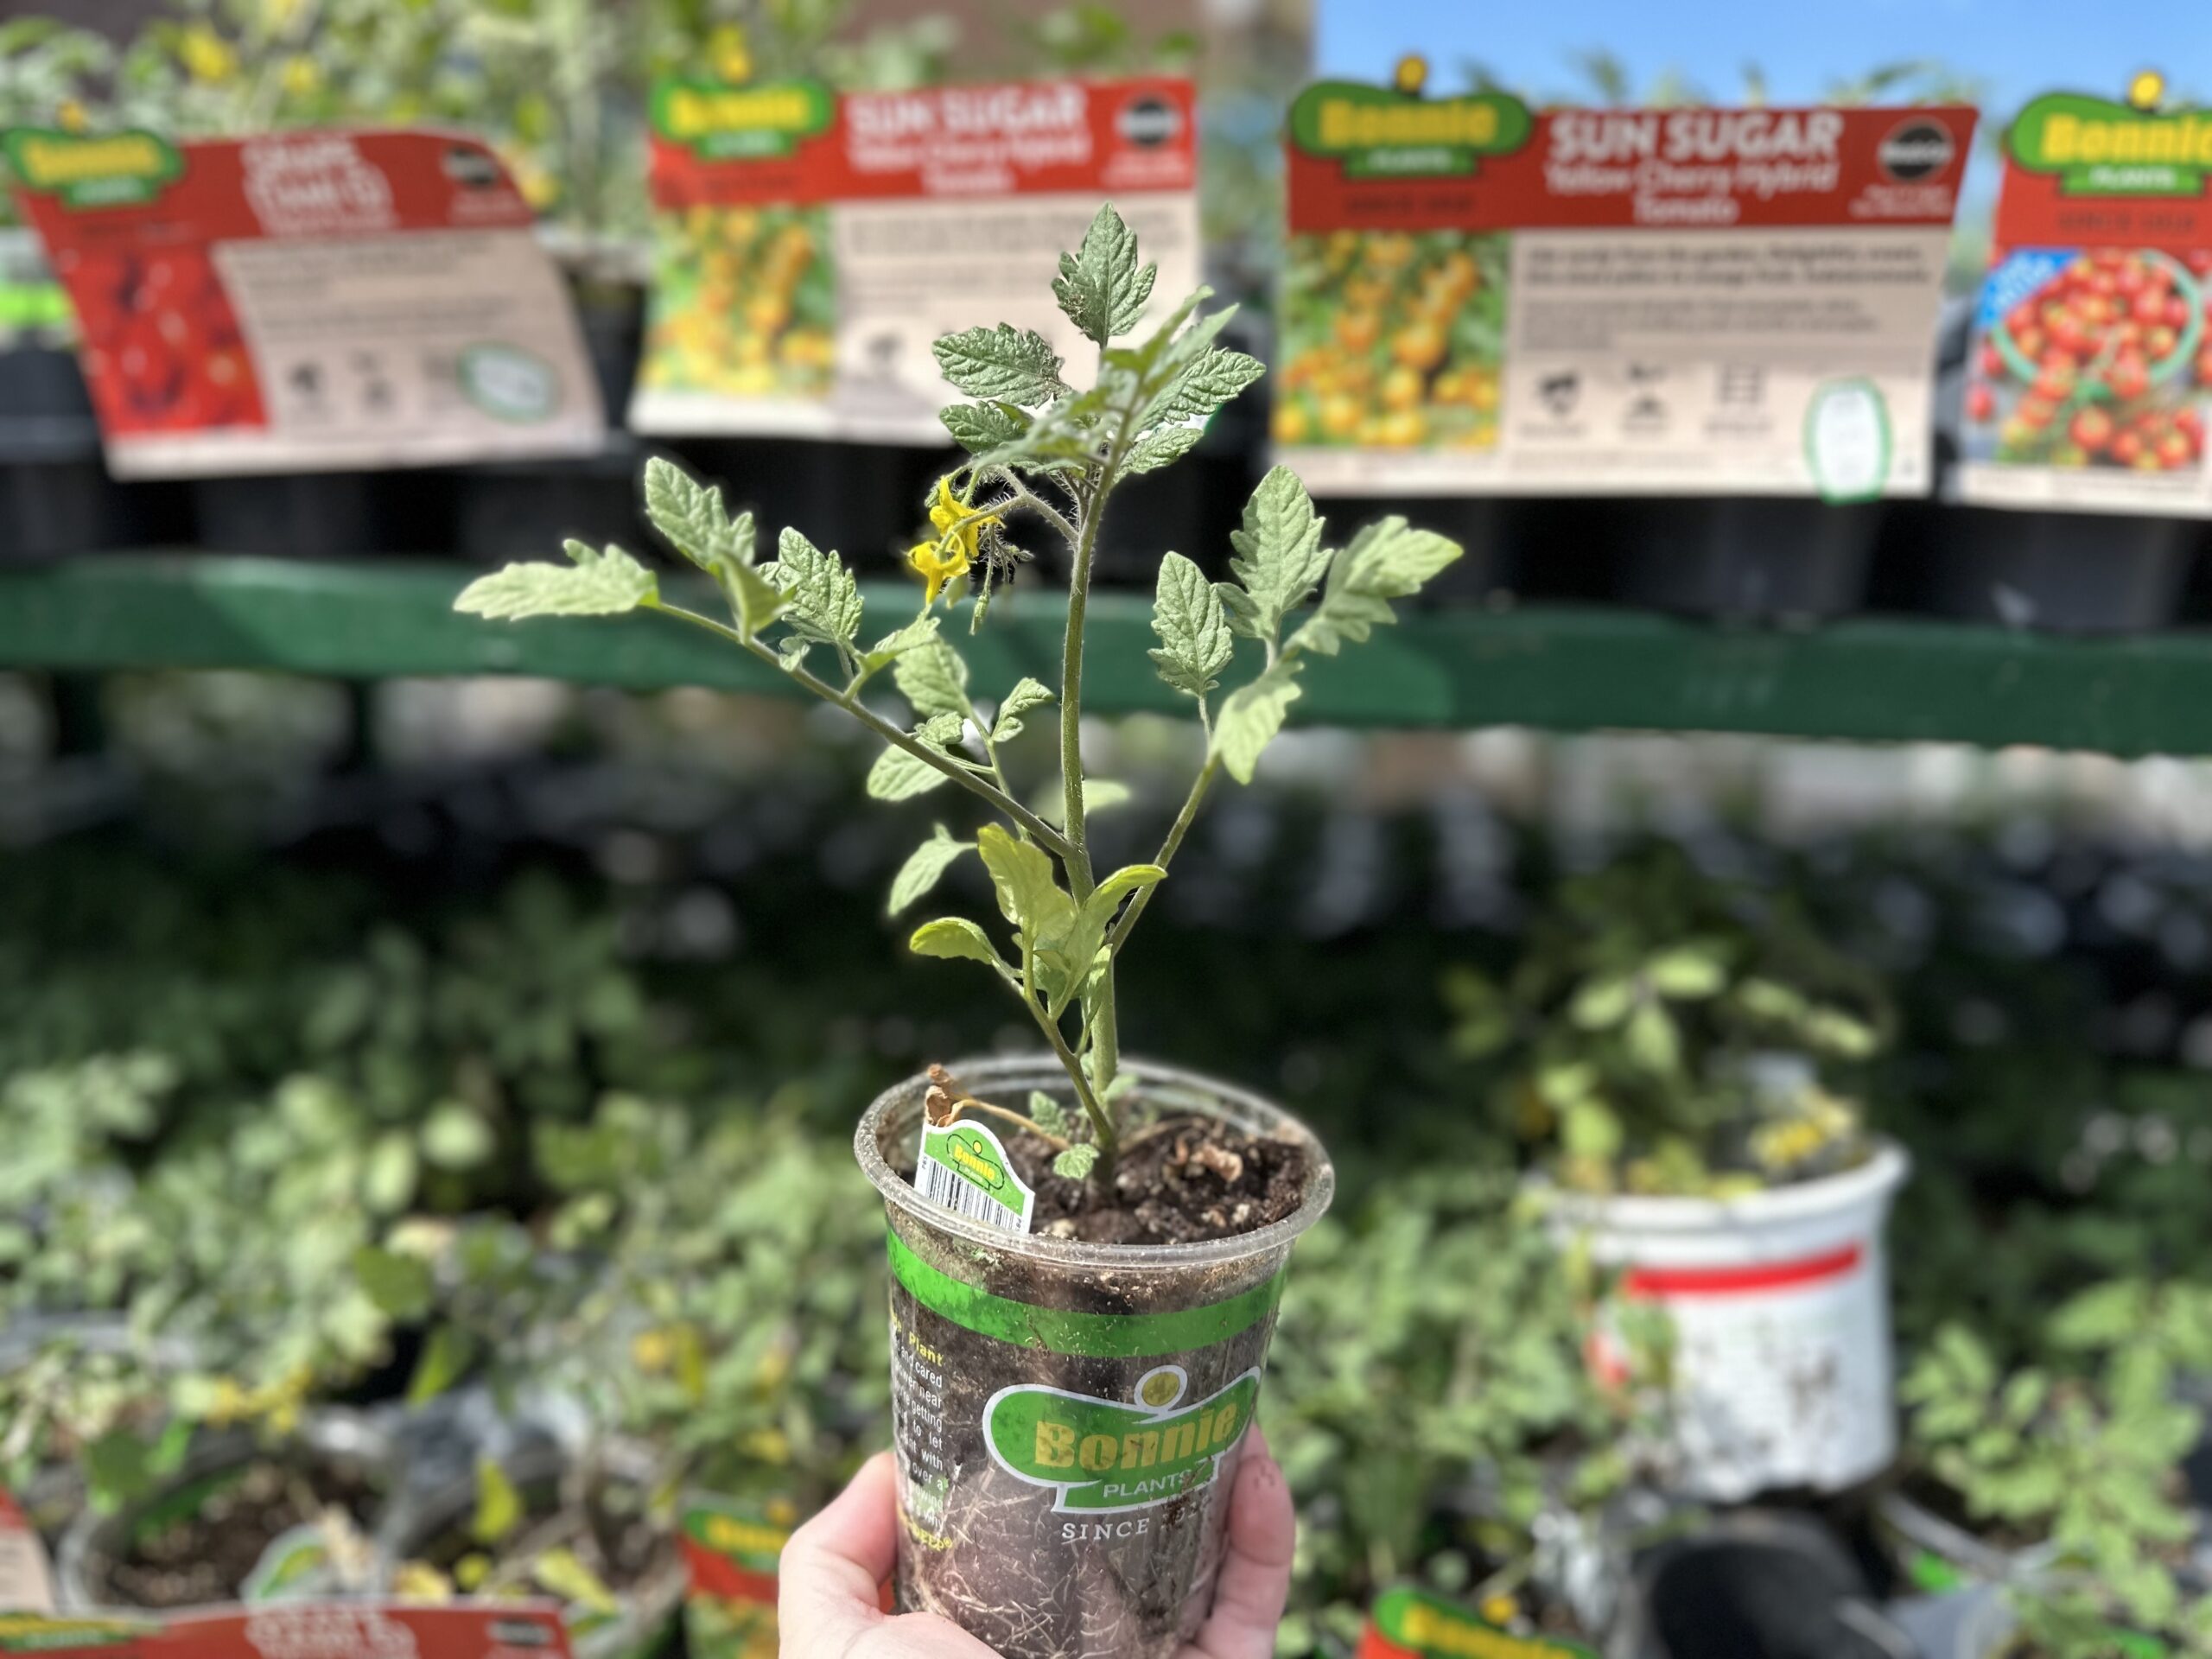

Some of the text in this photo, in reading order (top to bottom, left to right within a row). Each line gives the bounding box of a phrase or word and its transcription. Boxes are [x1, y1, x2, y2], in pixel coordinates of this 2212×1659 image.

[847, 95, 935, 133] SUN
[943, 84, 1087, 130] SUGAR
[1552, 112, 1656, 161] SUN
[1665, 112, 1843, 161] SUGAR
[954, 1143, 995, 1181] Bonnie
[909, 1332, 944, 1366] Plant
[916, 1361, 943, 1388] cared
[920, 1386, 942, 1409] near
[912, 1401, 943, 1433] getting
[913, 1420, 943, 1451] to let
[1034, 1402, 1238, 1471] Bonnie
[921, 1449, 943, 1471] with
[912, 1462, 943, 1491] over a
[1103, 1469, 1192, 1498] PLANTS
[1061, 1517, 1150, 1541] SINCE
